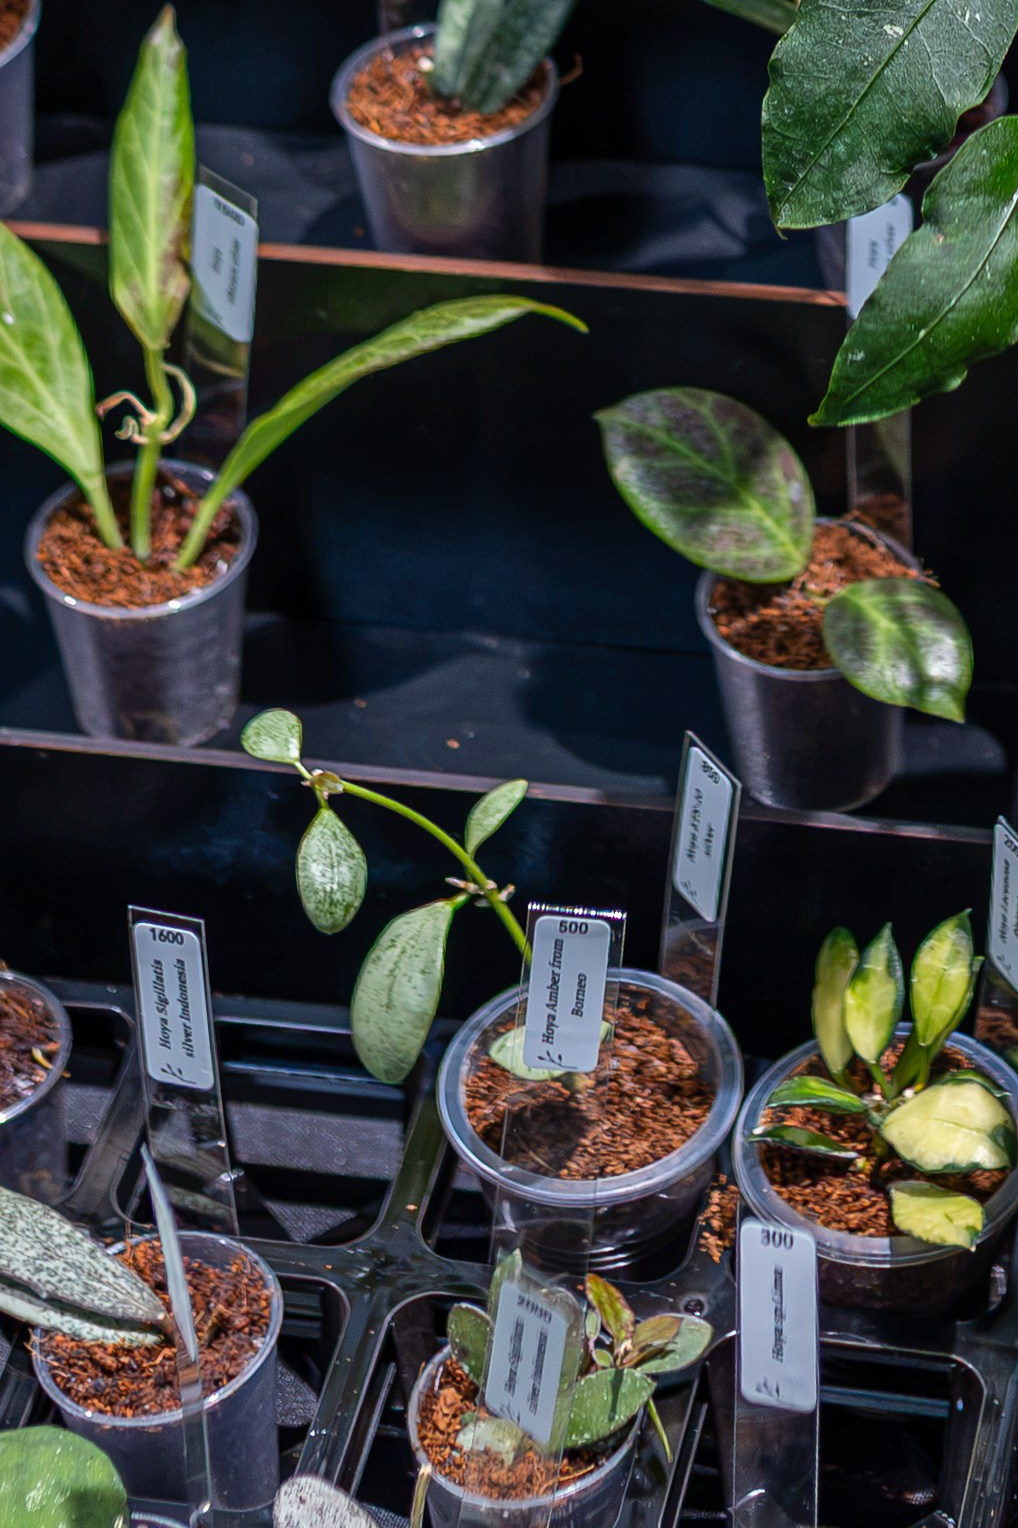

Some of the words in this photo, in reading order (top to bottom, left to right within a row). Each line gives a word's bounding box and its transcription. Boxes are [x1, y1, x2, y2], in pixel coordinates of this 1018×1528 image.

[149, 928, 184, 946] 1600
[559, 920, 589, 935] 500
[548, 938, 564, 970] from
[150, 959, 170, 1015] Sigillatis
[173, 958, 191, 1022] Indonesia
[545, 972, 561, 1012] Amber
[571, 973, 587, 1018] Borneo
[159, 1018, 172, 1050] Hoya
[181, 1024, 195, 1059] silver
[542, 1014, 559, 1045] Hoya
[761, 1228, 794, 1251] 300
